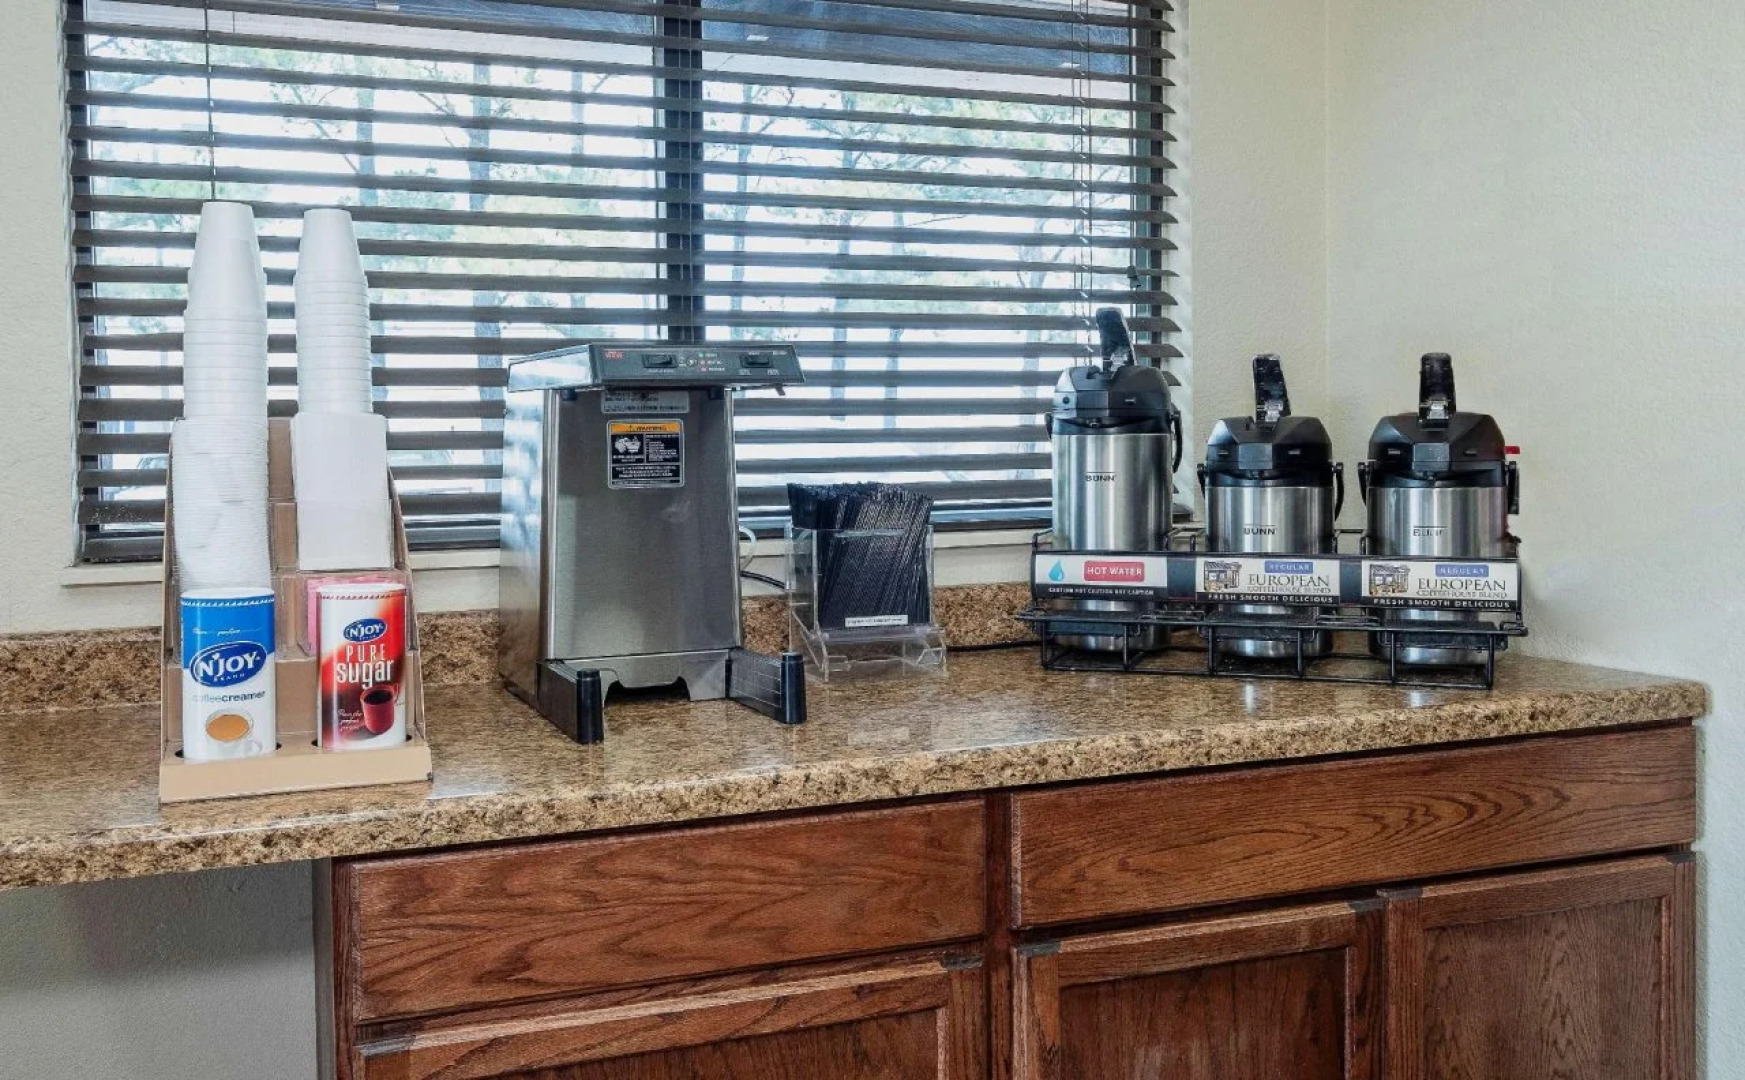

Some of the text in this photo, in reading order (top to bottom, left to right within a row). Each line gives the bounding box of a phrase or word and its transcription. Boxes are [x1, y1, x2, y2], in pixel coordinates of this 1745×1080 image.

[1087, 566, 1142, 576] HOT WATER
[1248, 574, 1330, 587] EUROPEAN
[1418, 577, 1506, 591] EUROPEAN
[1240, 594, 1279, 602] SMOOTH
[1282, 595, 1333, 604] DELICIOUS
[1455, 600, 1510, 608] DELICIOUS
[346, 644, 386, 662] PURE
[336, 659, 394, 690] sugar
